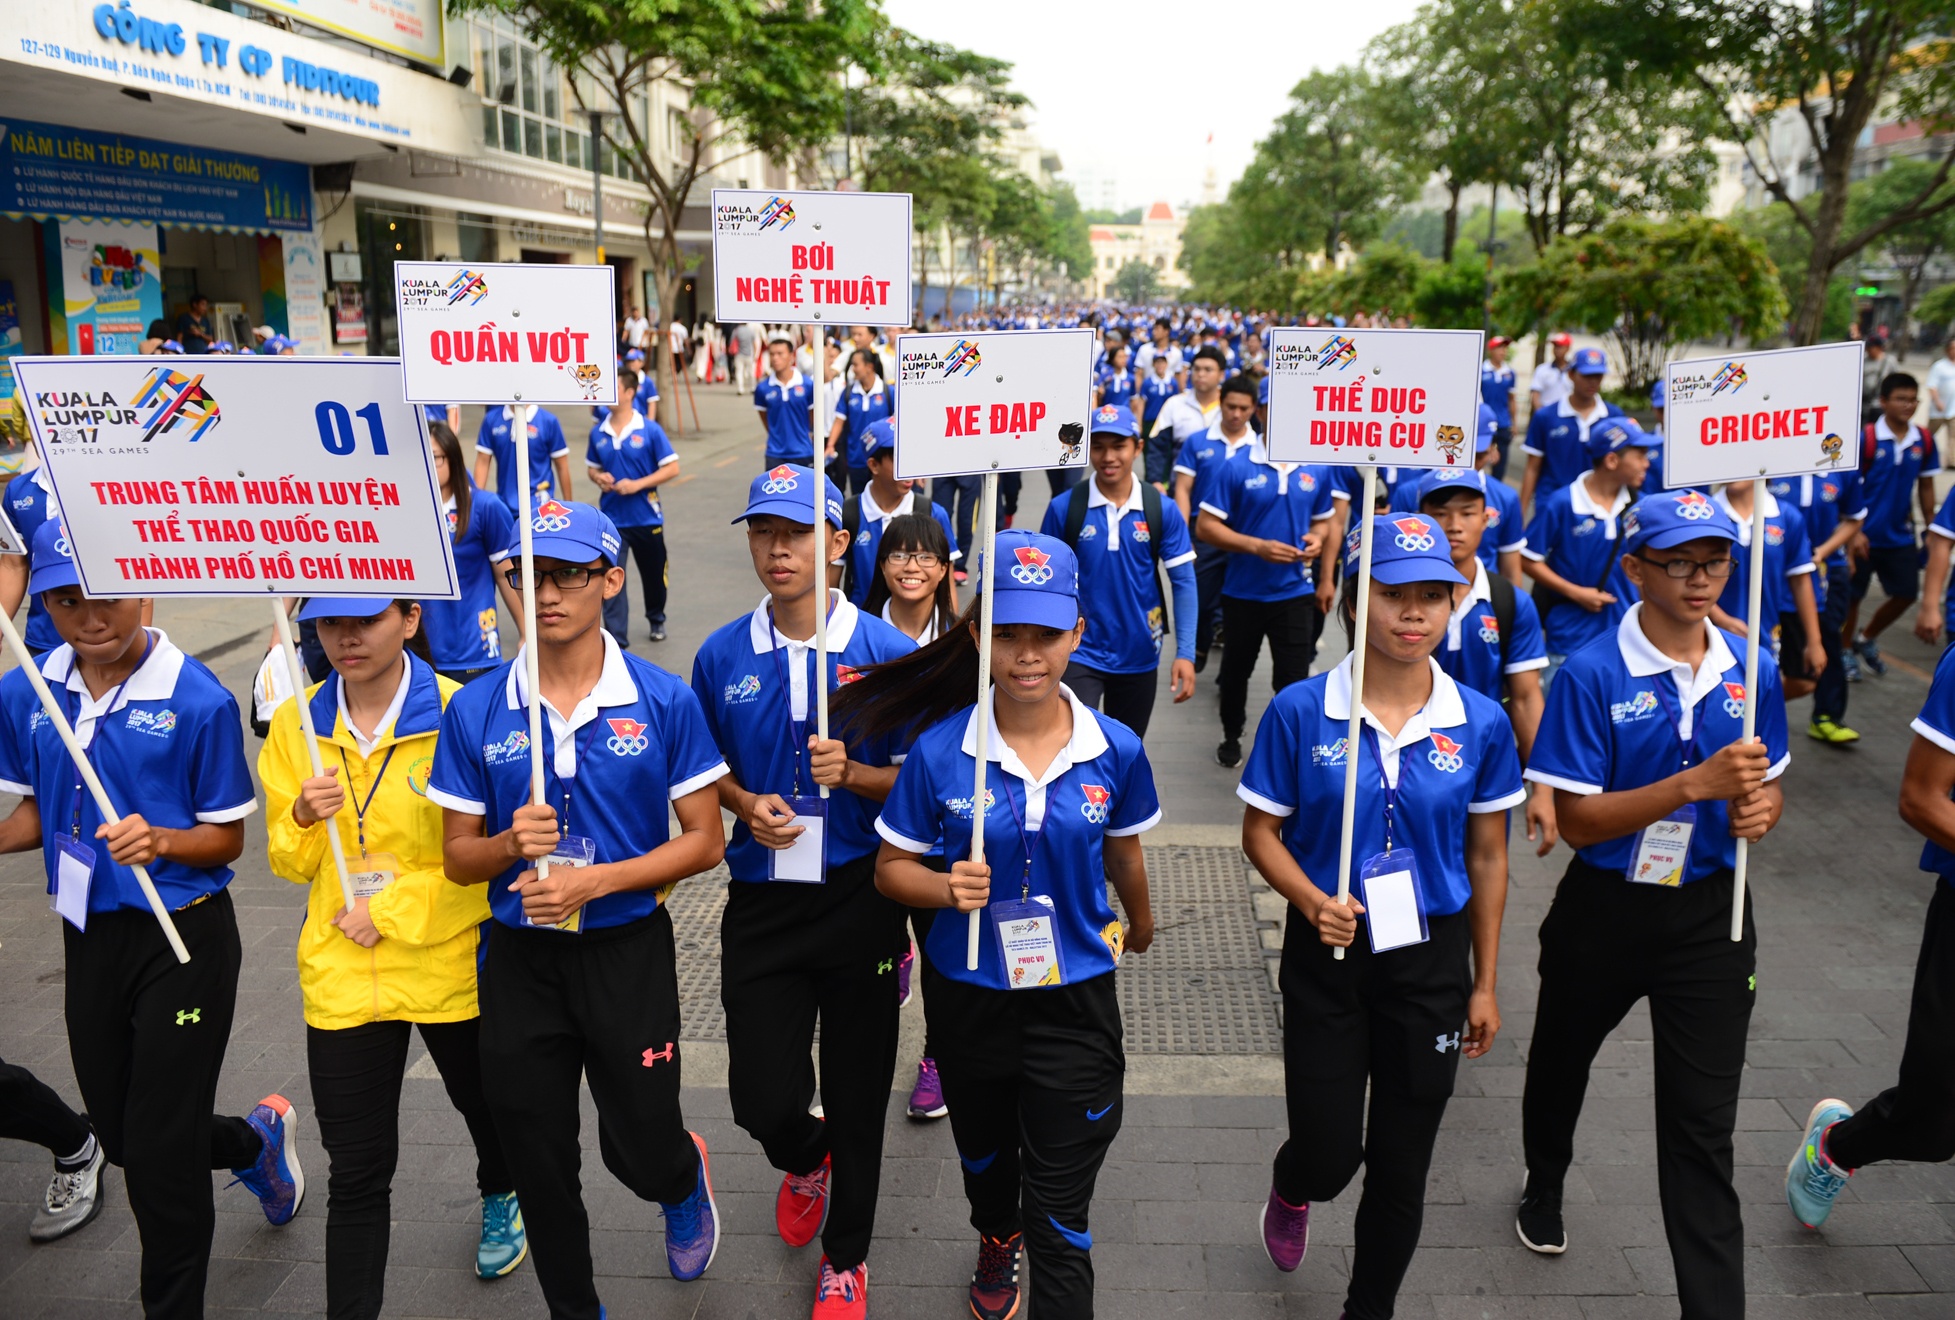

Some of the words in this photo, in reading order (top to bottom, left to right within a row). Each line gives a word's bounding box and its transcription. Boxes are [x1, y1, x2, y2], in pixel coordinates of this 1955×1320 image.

[20, 38, 61, 59] 127-129
[93, 0, 187, 56] CÔNG
[197, 32, 230, 68] TY
[239, 45, 273, 77] CP
[282, 56, 380, 107] FIDITOUR
[10, 130, 54, 157] NĂM
[57, 136, 95, 162] LIÊN
[98, 138, 135, 166] TIẾP
[139, 150, 169, 175] ĐẠT
[718, 206, 752, 214] KUALA
[718, 214, 759, 223] LUMPUR
[792, 241, 833, 270] BƠI
[402, 279, 440, 288] KUALA
[736, 273, 803, 308] NGHỆ
[810, 275, 890, 310] THUẬT
[403, 289, 448, 297] LUMPUR
[404, 298, 428, 306] 2017
[430, 322, 519, 365] QUẦN
[527, 327, 589, 369] VỢT
[1276, 345, 1311, 353] KUALA
[902, 353, 938, 362] KUALA
[1276, 354, 1318, 362] LUMPUR
[902, 362, 945, 370] LUMPUR
[1275, 362, 1299, 370] 2017
[902, 372, 925, 380] 2017
[1672, 375, 1705, 385] KUALA
[1672, 382, 1712, 392] LUMPUR
[36, 391, 118, 408] KUALA
[1313, 375, 1365, 412] THỂ
[1371, 387, 1426, 419] DỤC
[1672, 392, 1694, 400] 2017
[42, 409, 140, 426] LUMPUR
[945, 405, 981, 437] XE
[989, 402, 1045, 439] ĐẠP
[314, 401, 390, 456] 01
[1700, 406, 1829, 446] CRICKET
[48, 428, 99, 444] 2017
[1310, 420, 1382, 451] DỤNG
[1389, 422, 1425, 454] CỤ
[81, 447, 104, 455] SEA
[109, 447, 150, 455] GAMES
[90, 481, 180, 505] TRUNG
[182, 477, 240, 505] TÂM
[243, 474, 315, 506] HUẤN
[318, 478, 400, 512] LUYỆN
[132, 510, 185, 543] THỂ
[188, 520, 255, 543] THAO
[260, 513, 330, 545] QUỐC
[335, 521, 379, 543] GIA
[115, 553, 201, 581] THÀNH
[204, 550, 255, 581] PHỐ
[257, 551, 296, 581] HỒ
[300, 553, 344, 581] CHÍ
[348, 559, 415, 582] MINH
[1018, 956, 1035, 964] PHỤC
